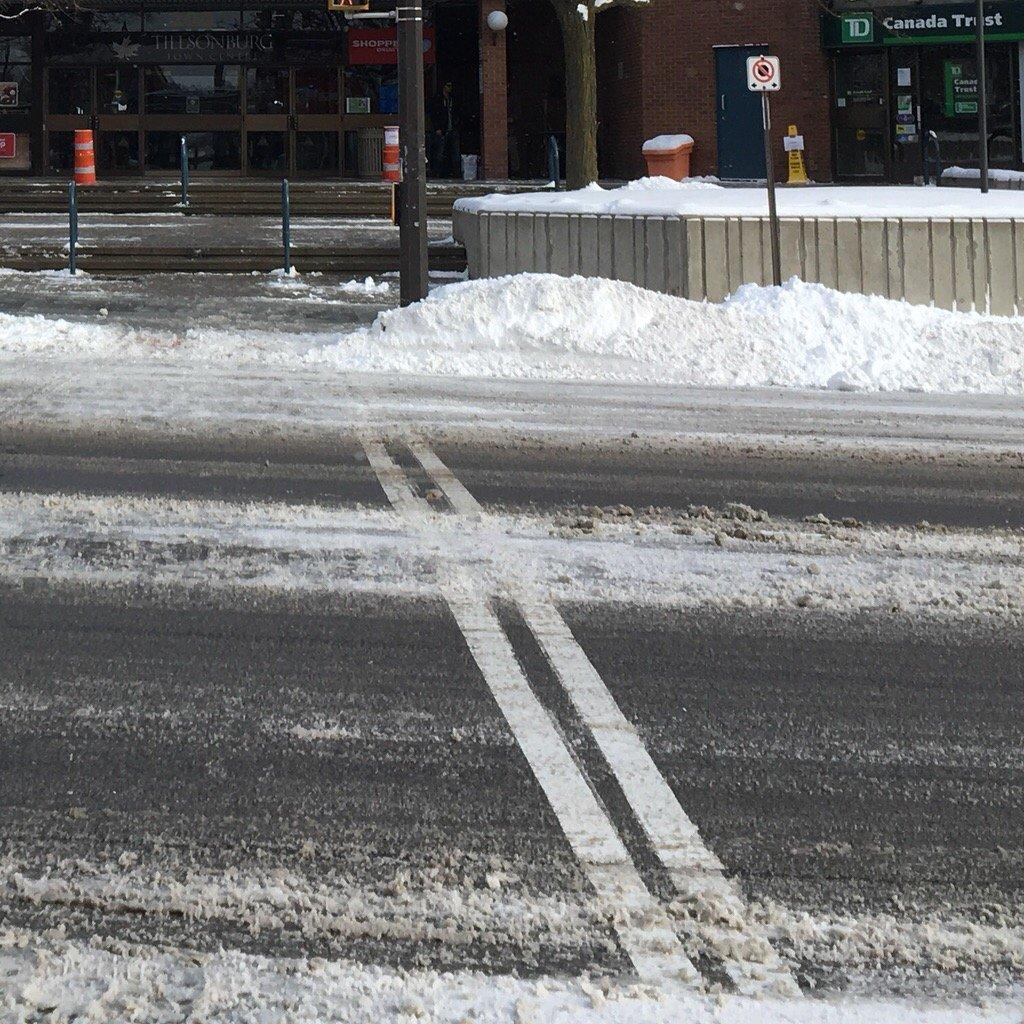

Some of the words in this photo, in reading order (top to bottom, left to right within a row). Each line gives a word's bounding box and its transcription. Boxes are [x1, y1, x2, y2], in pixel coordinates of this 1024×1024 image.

[845, 18, 870, 37] TD
[883, 15, 947, 30] Canada
[151, 35, 274, 51] TILLSONBURG
